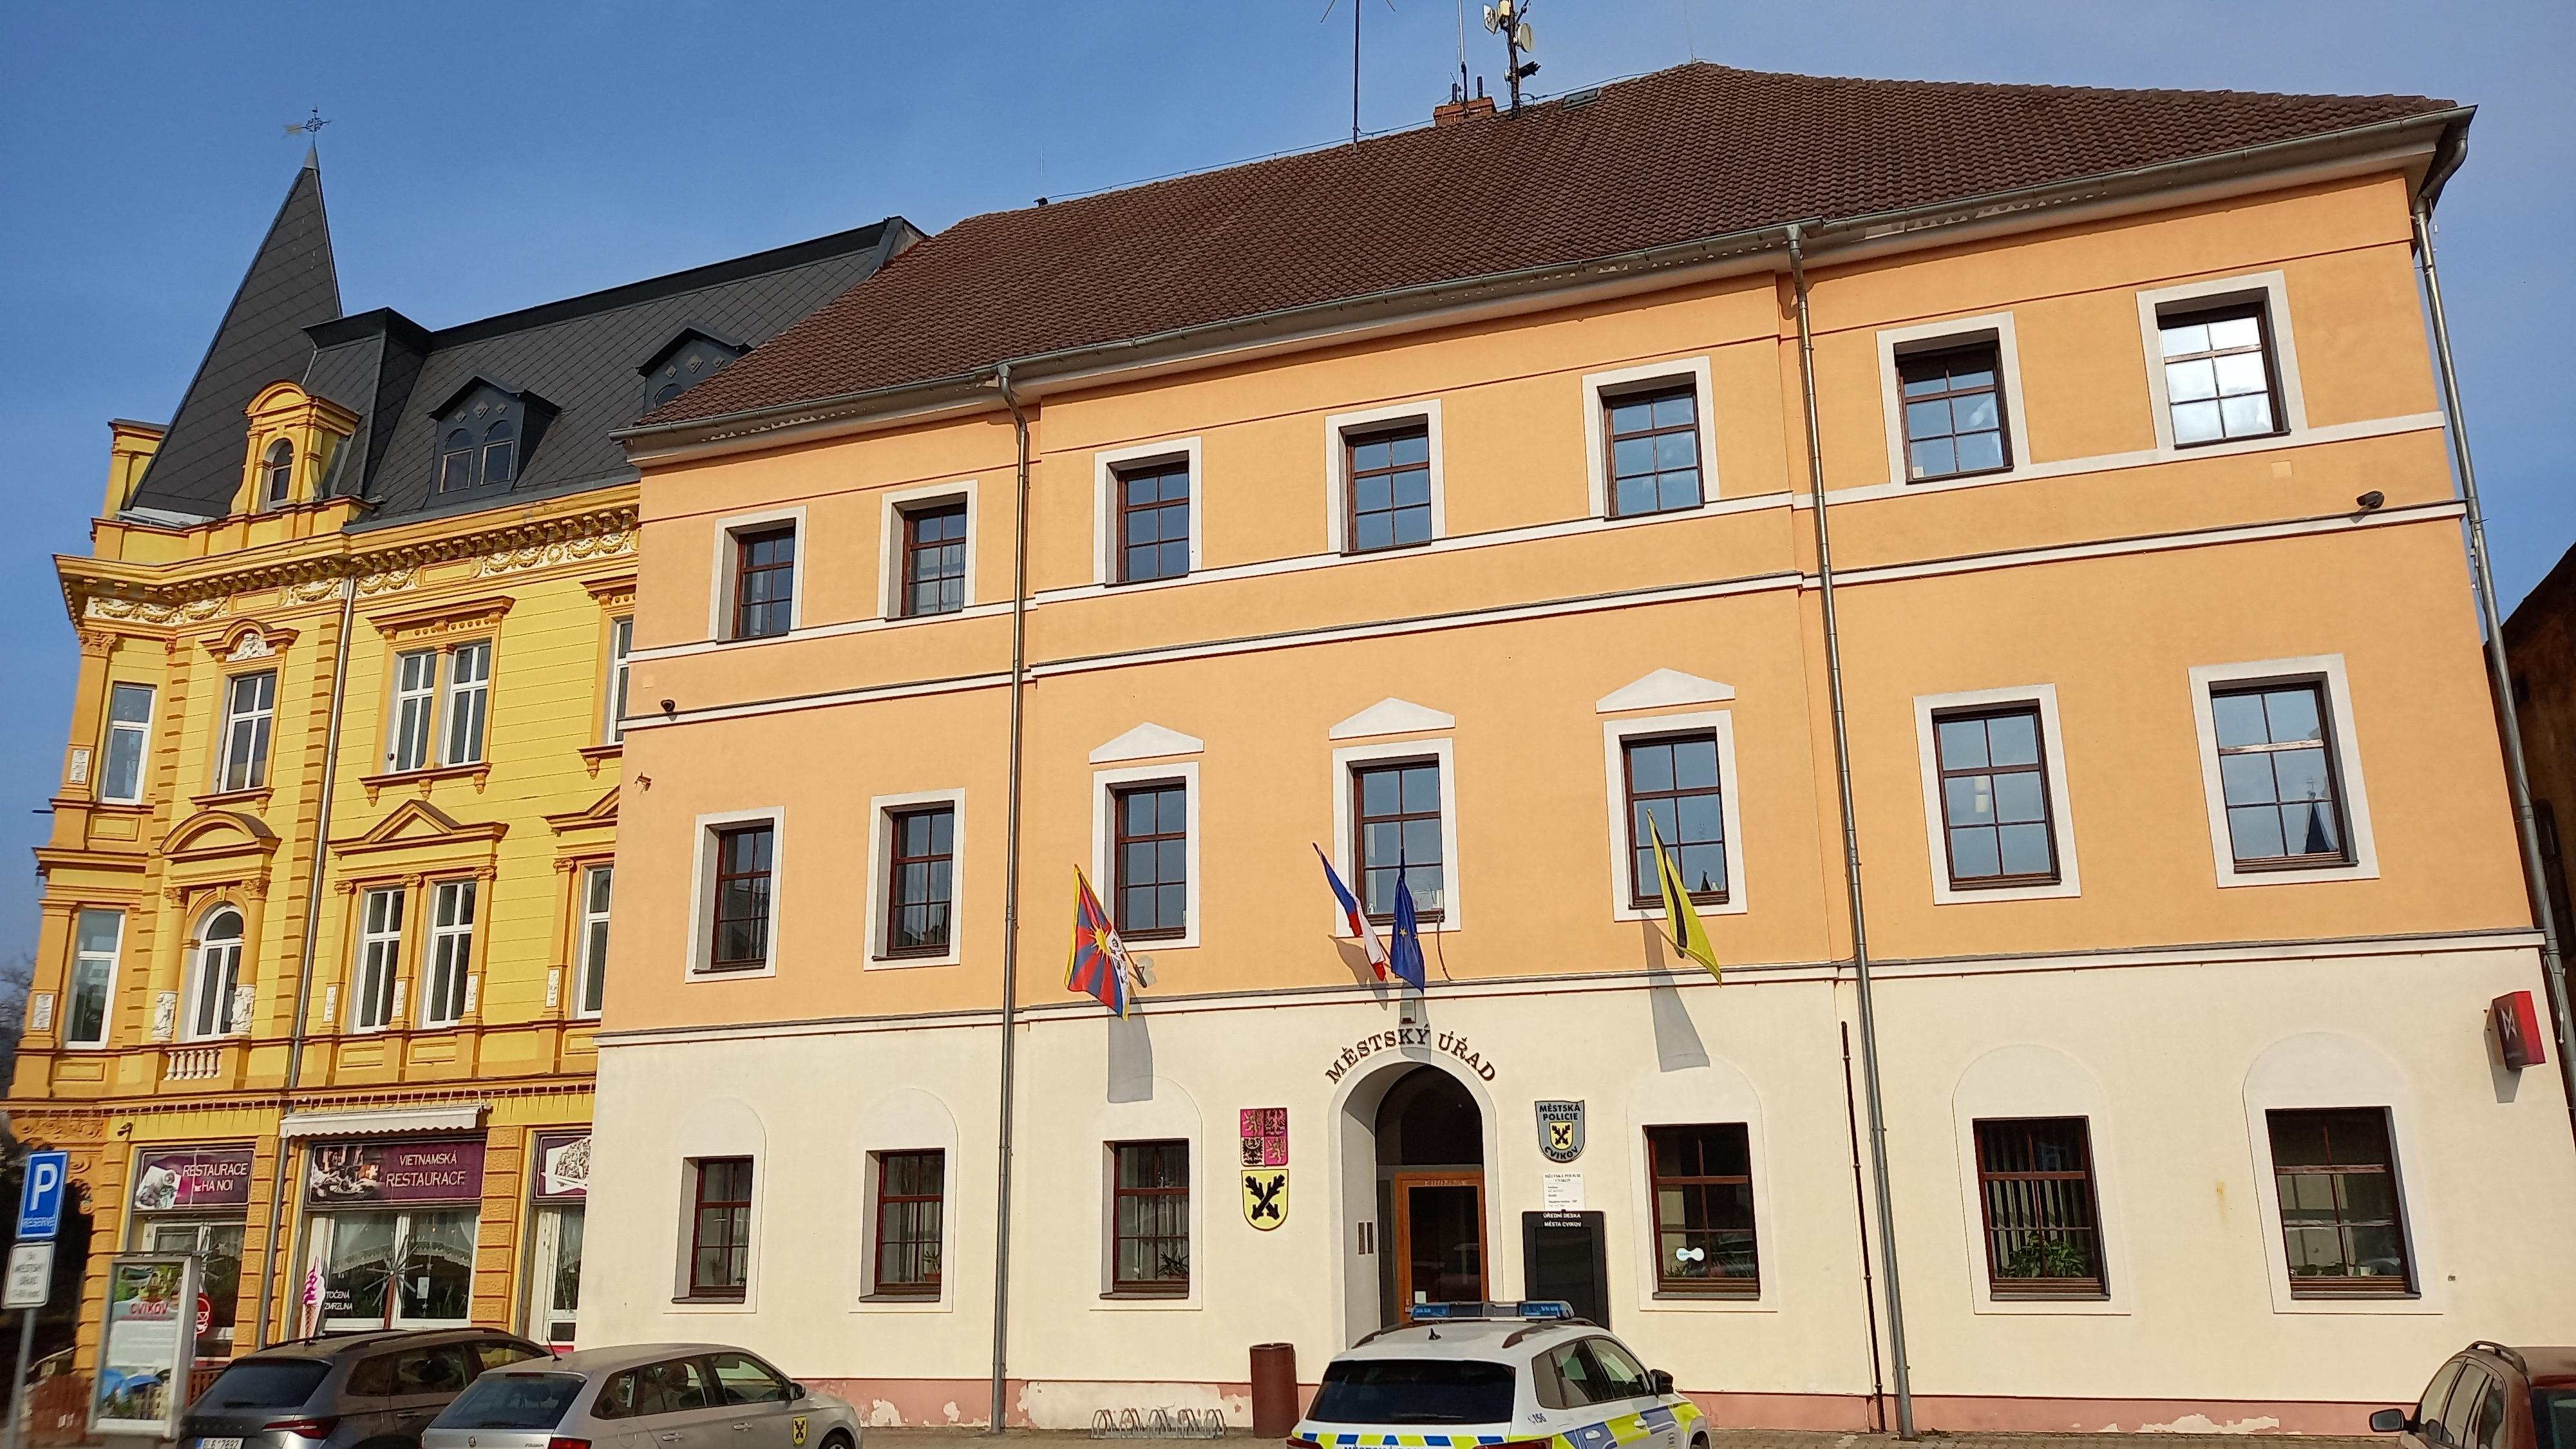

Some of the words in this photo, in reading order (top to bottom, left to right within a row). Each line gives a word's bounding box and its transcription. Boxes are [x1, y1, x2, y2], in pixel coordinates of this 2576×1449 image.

[1325, 1023, 1430, 1084] MĚSTSKÝ
[1438, 1030, 1496, 1082] ÚŘAD
[399, 1150, 457, 1166] VIETNAMSKÁ
[1544, 1146, 1578, 1159] CVIKOV
[182, 1162, 249, 1177] RESTAURACE
[30, 1163, 58, 1211] P
[386, 1171, 467, 1188] RESTAURACE
[326, 1289, 350, 1299] TOČENÁ
[130, 1302, 169, 1315] CVIKOV
[324, 1302, 353, 1311] ZMRZLINA
